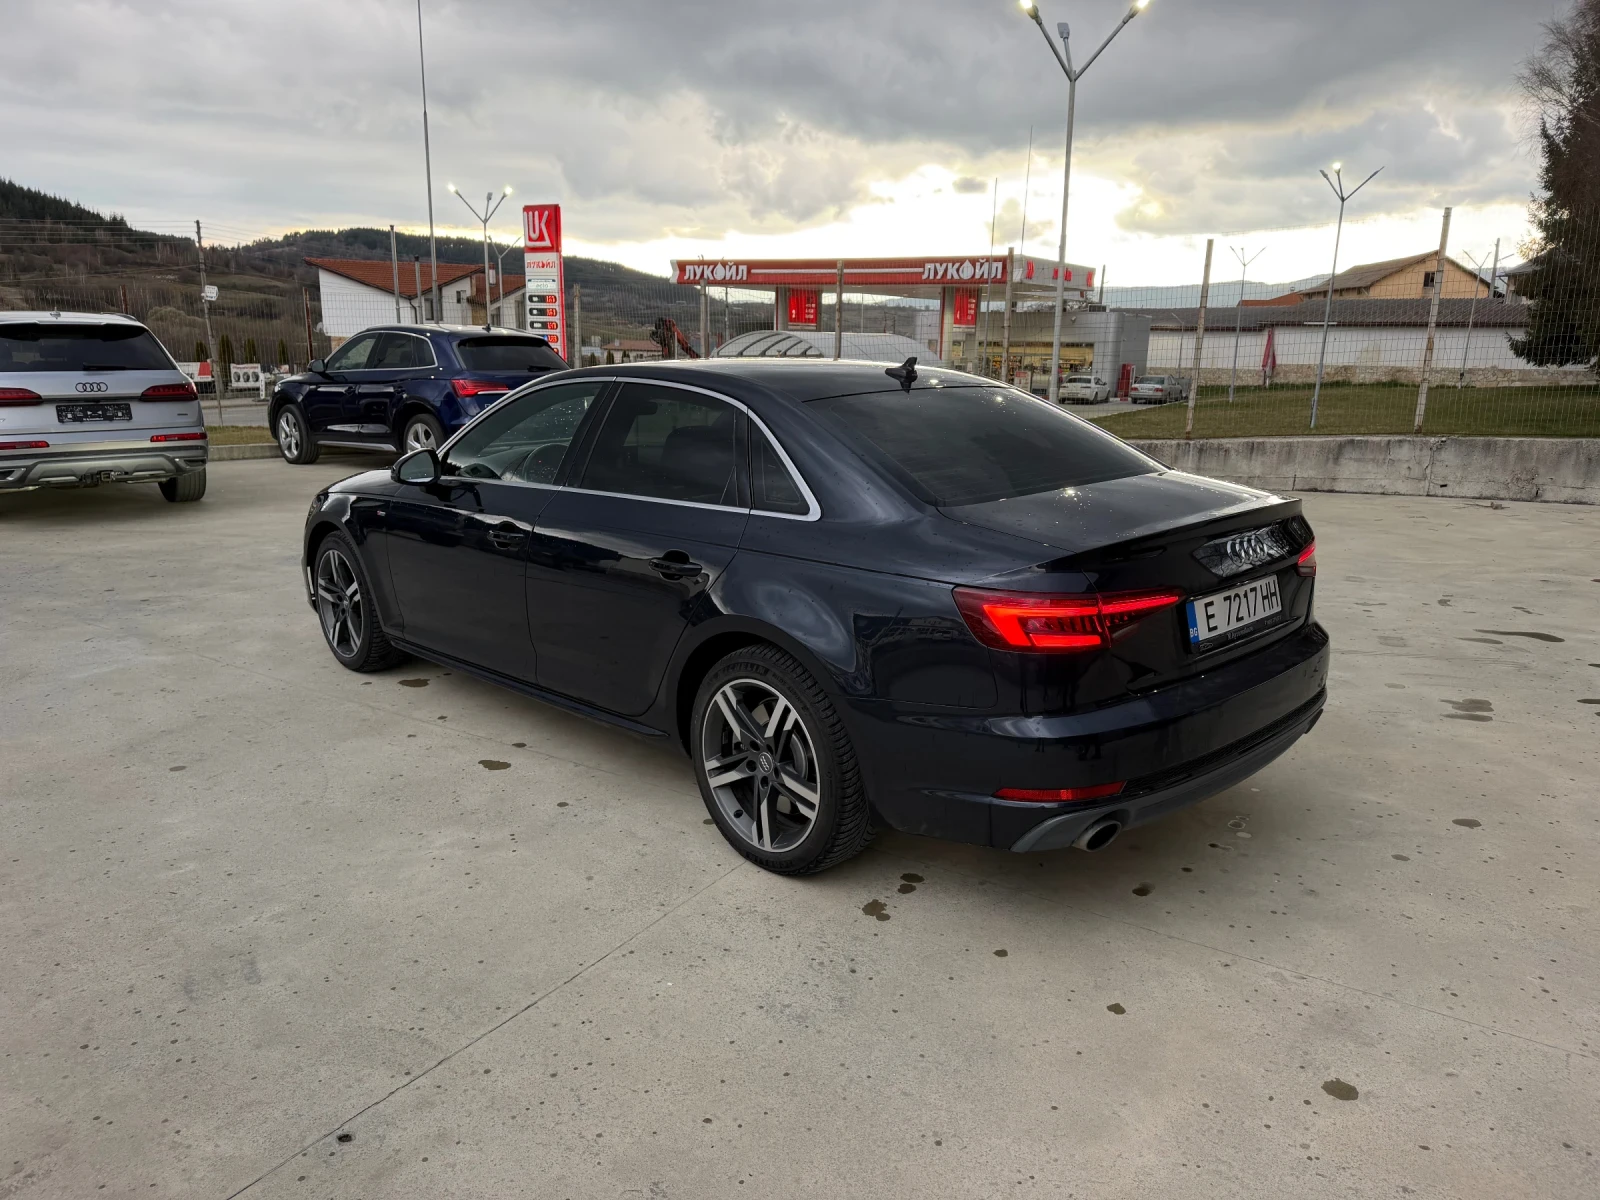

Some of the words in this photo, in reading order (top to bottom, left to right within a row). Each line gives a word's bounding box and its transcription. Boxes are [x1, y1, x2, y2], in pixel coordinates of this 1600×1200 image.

[684, 261, 747, 280] ЛУКОЙЛ
[922, 258, 1002, 280] ЛУКОЙЛ
[1204, 600, 1218, 632] E
[1223, 586, 1257, 627] 7217
[1260, 579, 1279, 613] HH
[1190, 627, 1198, 637] BG
